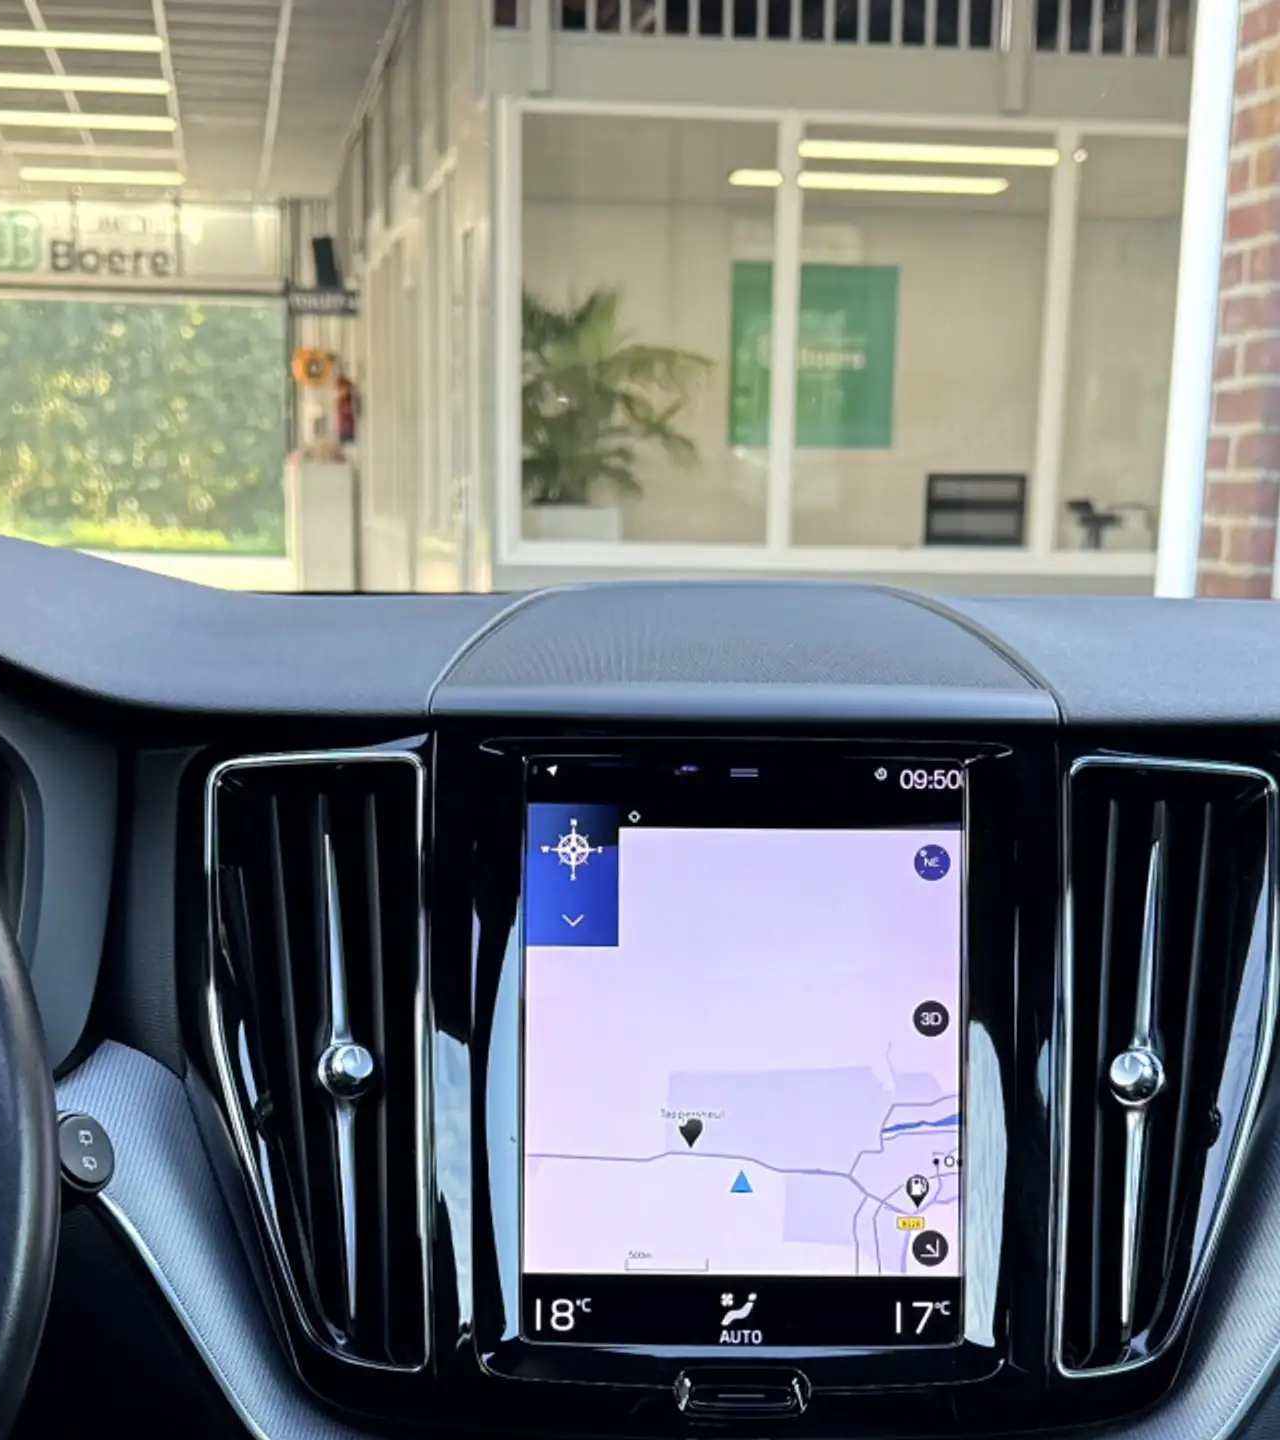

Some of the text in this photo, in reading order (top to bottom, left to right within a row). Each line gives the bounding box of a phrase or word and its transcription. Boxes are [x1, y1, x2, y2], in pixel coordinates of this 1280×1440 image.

[50, 239, 170, 275] Boere
[900, 768, 960, 790] 09:50
[920, 1011, 943, 1026] 3D
[720, 1329, 764, 1344] AUTO
